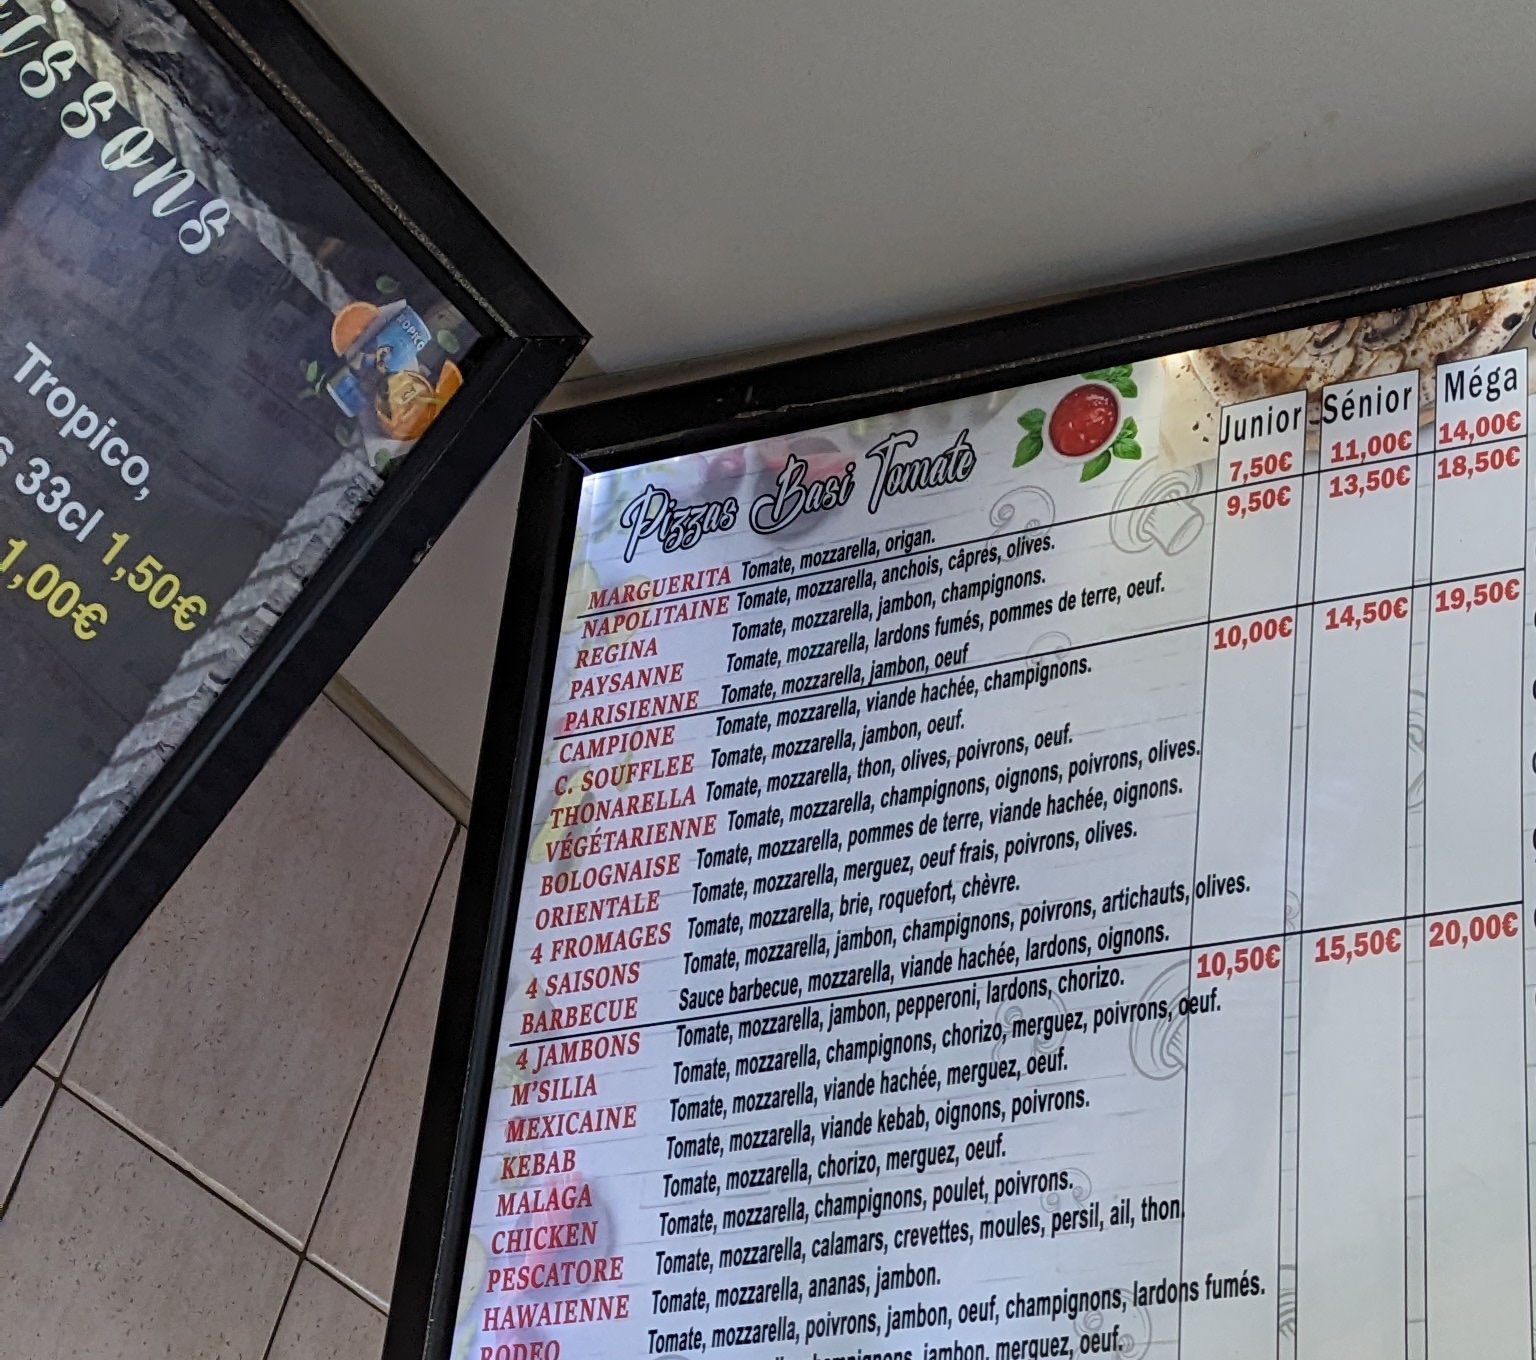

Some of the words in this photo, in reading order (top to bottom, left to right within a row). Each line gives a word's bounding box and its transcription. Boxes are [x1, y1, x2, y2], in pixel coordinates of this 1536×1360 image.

[13, 342, 151, 501] Tropico,
[1220, 405, 1303, 446] Junior
[1322, 385, 1412, 424] Sénior
[1444, 365, 1518, 404] Méga
[1229, 450, 1293, 485] 7,50€
[1330, 430, 1412, 464] 11,00€
[1438, 410, 1521, 445] 14,00€
[1226, 485, 1292, 518] 9,50€
[1328, 464, 1411, 499] 13,50€
[1436, 445, 1521, 481] 18,50€
[620, 483, 739, 563] Pizzas
[750, 453, 856, 535] Basi
[15, 457, 105, 542] 33cl
[102, 531, 208, 631] 1,50€
[0, 538, 109, 640] 1,00€
[589, 566, 731, 609] MARGUERITA
[741, 554, 796, 581] Tomate,
[799, 536, 880, 570] mozzarella,
[884, 528, 936, 554] origan.
[584, 595, 730, 637] NAPOLITAINE
[1214, 615, 1294, 651] 10,00€
[1325, 596, 1409, 631] 14,50€
[1434, 578, 1520, 613] 19,50€
[575, 638, 658, 669] REGINA
[570, 663, 683, 700] PAYSANNE
[559, 690, 699, 736] PARISIENNE
[559, 725, 675, 764] CAMPIONE
[554, 774, 572, 798] C.
[580, 753, 693, 793] SOUFFLEE
[551, 785, 696, 829] THONARELLA
[546, 814, 717, 862] VÉGÉTARIENNE
[535, 890, 660, 930] ORIENTALE
[691, 877, 748, 905] Tomate,
[752, 862, 839, 895] mozzarella,
[842, 855, 914, 883] merguez,
[919, 842, 958, 870] oeuf
[959, 838, 999, 865] frais,
[1003, 830, 1080, 863] poivrons,
[1084, 819, 1138, 845] olives.
[539, 853, 680, 897] BOLOGNAISE
[531, 944, 543, 965] 4
[550, 923, 672, 962] FROMAGES
[1196, 943, 1281, 979] 10,50€
[1314, 927, 1402, 964] 15,50€
[1428, 911, 1519, 948] 20,00€
[526, 977, 538, 1000] 4
[543, 960, 641, 997] SAISONS
[519, 996, 637, 1036] BARBECUE
[515, 1047, 529, 1070] 4
[532, 1031, 641, 1075] JAMBONS
[512, 1075, 597, 1106] M'SILIA
[504, 1104, 636, 1143] MEXICAINE
[500, 1148, 576, 1181] KEBAB
[497, 1183, 593, 1217] MALAGA
[491, 1220, 598, 1255] CHICKEN
[486, 1256, 624, 1294] PESCATORE
[482, 1294, 629, 1334] HAWAIENNE
